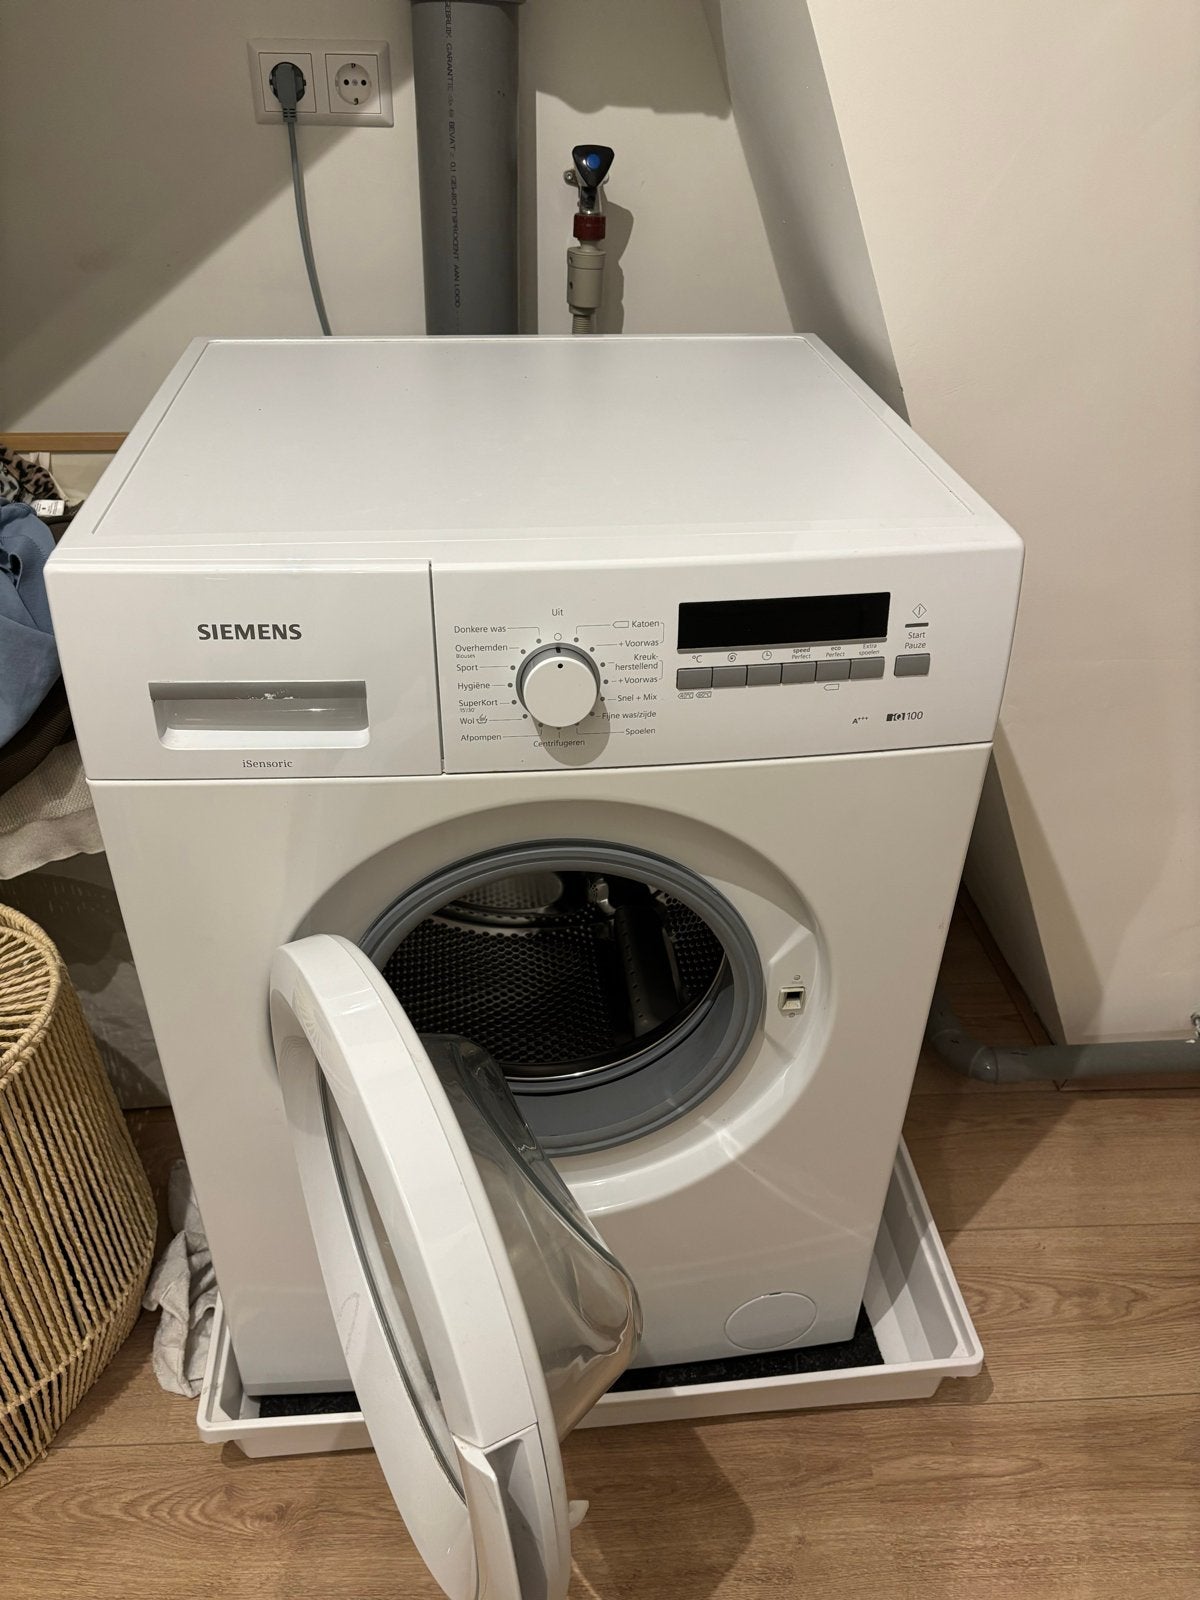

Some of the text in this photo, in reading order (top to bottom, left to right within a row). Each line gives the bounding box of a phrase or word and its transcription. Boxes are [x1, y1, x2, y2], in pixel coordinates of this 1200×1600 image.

[448, 121, 456, 151] BEVAT
[551, 608, 564, 617] Uit
[631, 620, 660, 628] Katoen
[197, 623, 303, 641] SIEMENS
[454, 625, 488, 633] Donkere
[908, 632, 926, 640] Start
[455, 643, 508, 652] Overhemden
[625, 639, 660, 648] Voorwas
[904, 642, 927, 650] Pauze
[633, 653, 659, 661] Kreuk-
[456, 663, 479, 673] Sport
[615, 662, 659, 671] herstellend
[624, 676, 658, 685] Voorwas
[457, 681, 491, 692] Hygiëne
[617, 693, 635, 702] Snel
[643, 692, 658, 701] Mix
[458, 699, 499, 708] SuperKort
[459, 716, 475, 725] Wol
[602, 712, 621, 721] Fijne
[625, 727, 657, 736] Spoelen
[460, 733, 502, 742] Afpompen
[533, 738, 586, 748] Centrifugeren
[242, 759, 293, 769] iSensoric
